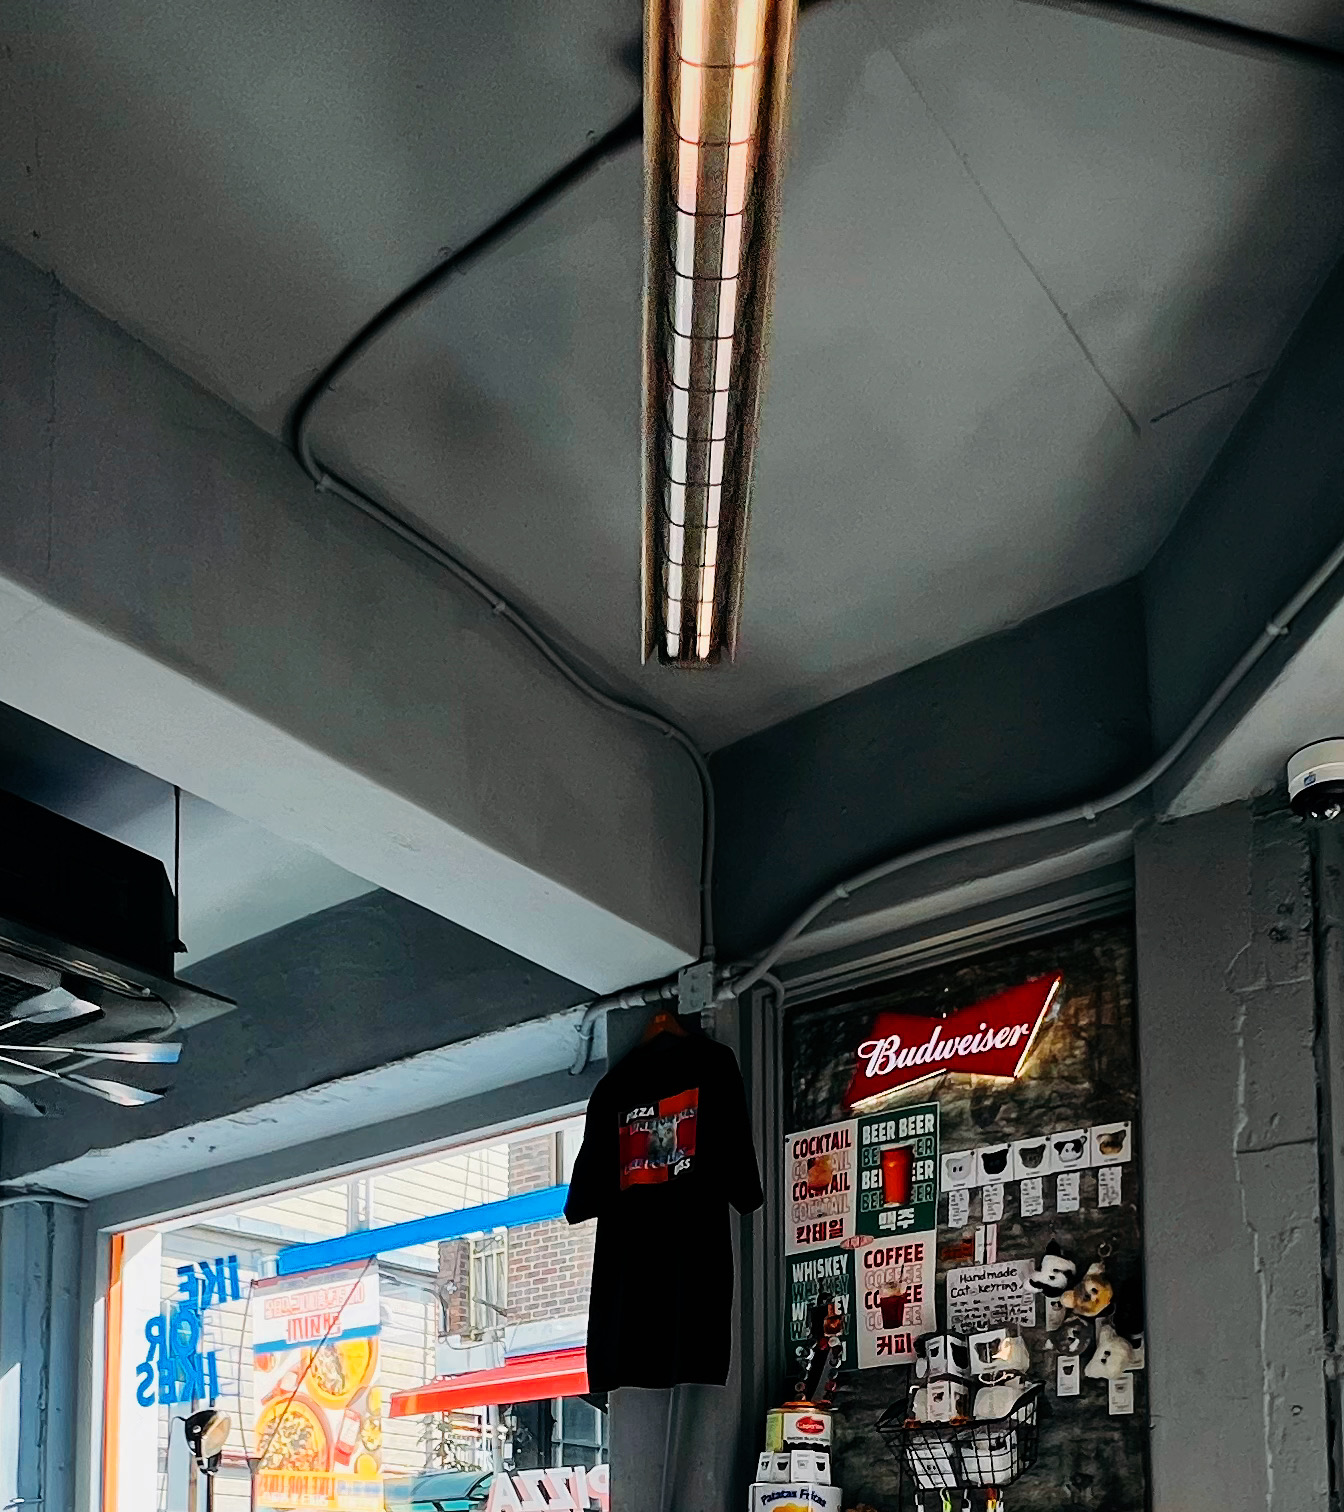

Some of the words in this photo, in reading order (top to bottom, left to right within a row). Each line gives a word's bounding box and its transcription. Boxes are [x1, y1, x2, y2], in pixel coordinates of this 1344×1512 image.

[857, 1022, 1029, 1078] Budweiser
[862, 1121, 896, 1145] BEER
[898, 1114, 935, 1138] BEER
[792, 1129, 851, 1159] COCKTAIL
[792, 1150, 851, 1181] COAIL
[796, 1218, 844, 1245] 칵테일
[878, 1208, 915, 1231] 맥주
[792, 1254, 849, 1282] WHISKEY
[863, 1243, 924, 1269] COFFEE
[876, 1332, 912, 1356] 커피
